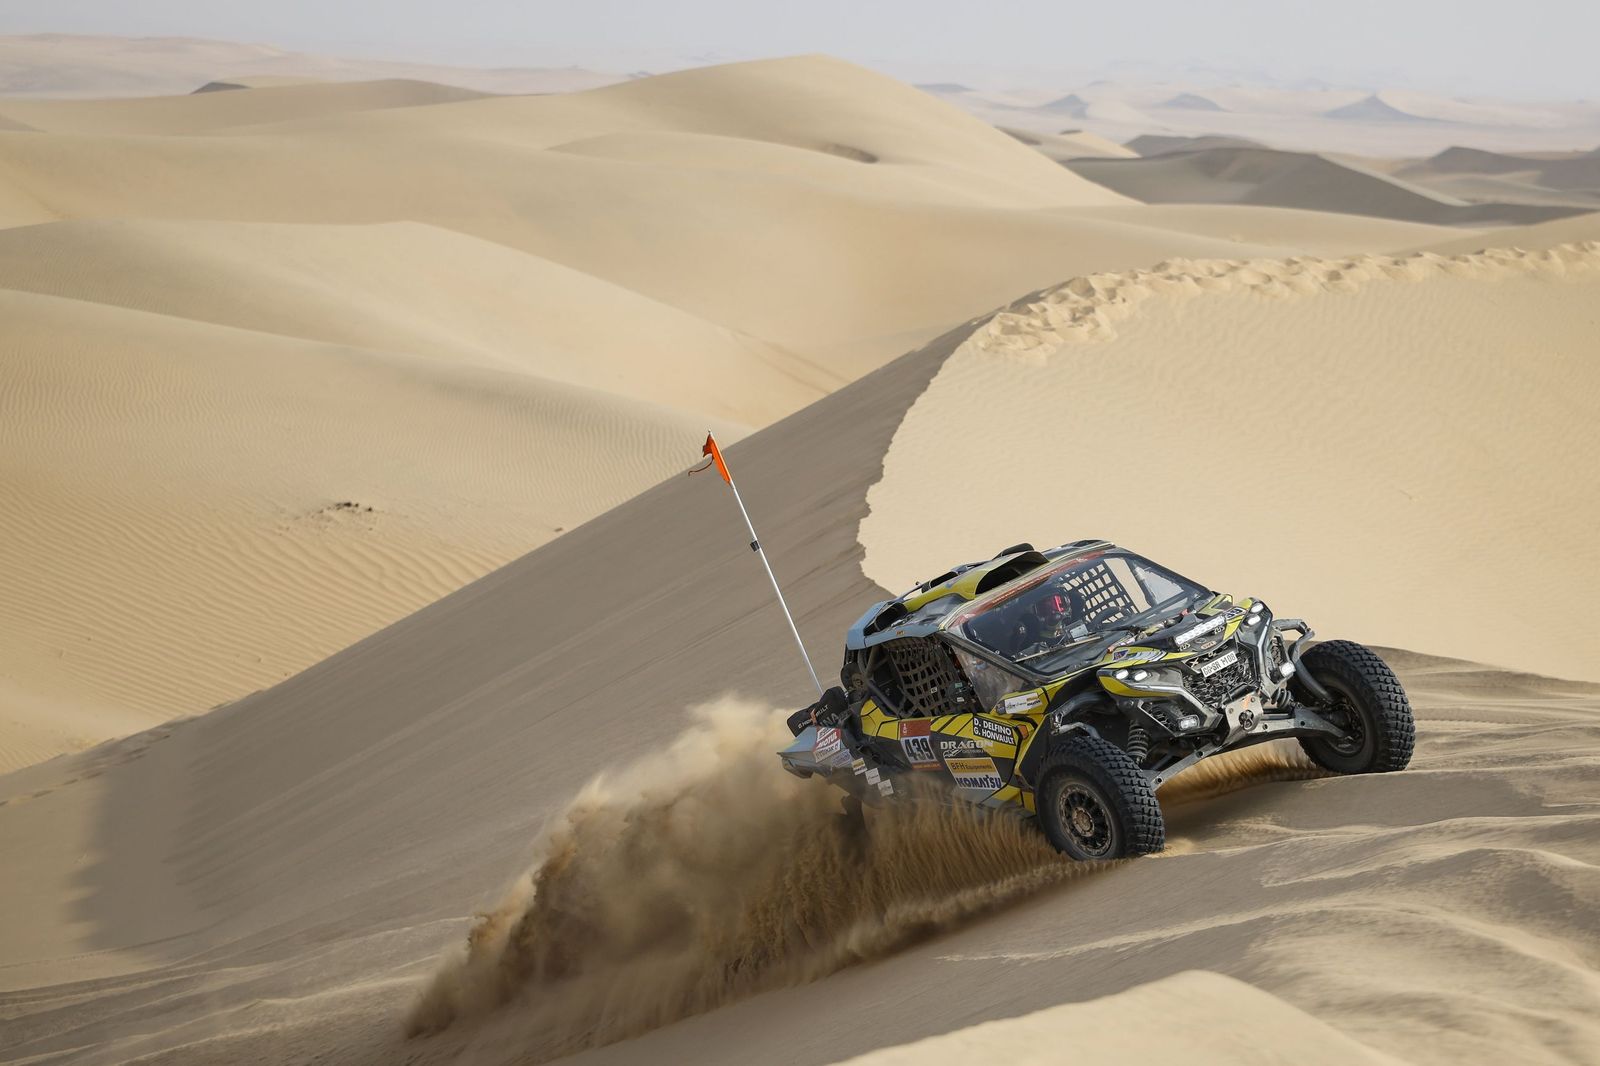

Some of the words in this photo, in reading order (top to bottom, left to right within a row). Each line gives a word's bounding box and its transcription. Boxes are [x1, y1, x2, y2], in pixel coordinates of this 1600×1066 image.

[974, 717, 982, 727] D.
[983, 720, 1011, 736] DELFINO
[974, 727, 982, 735] G.
[982, 728, 1014, 745] HONVAULT
[904, 737, 935, 761] 439
[950, 762, 965, 770] BFH
[956, 775, 1002, 788] KOMATSU
